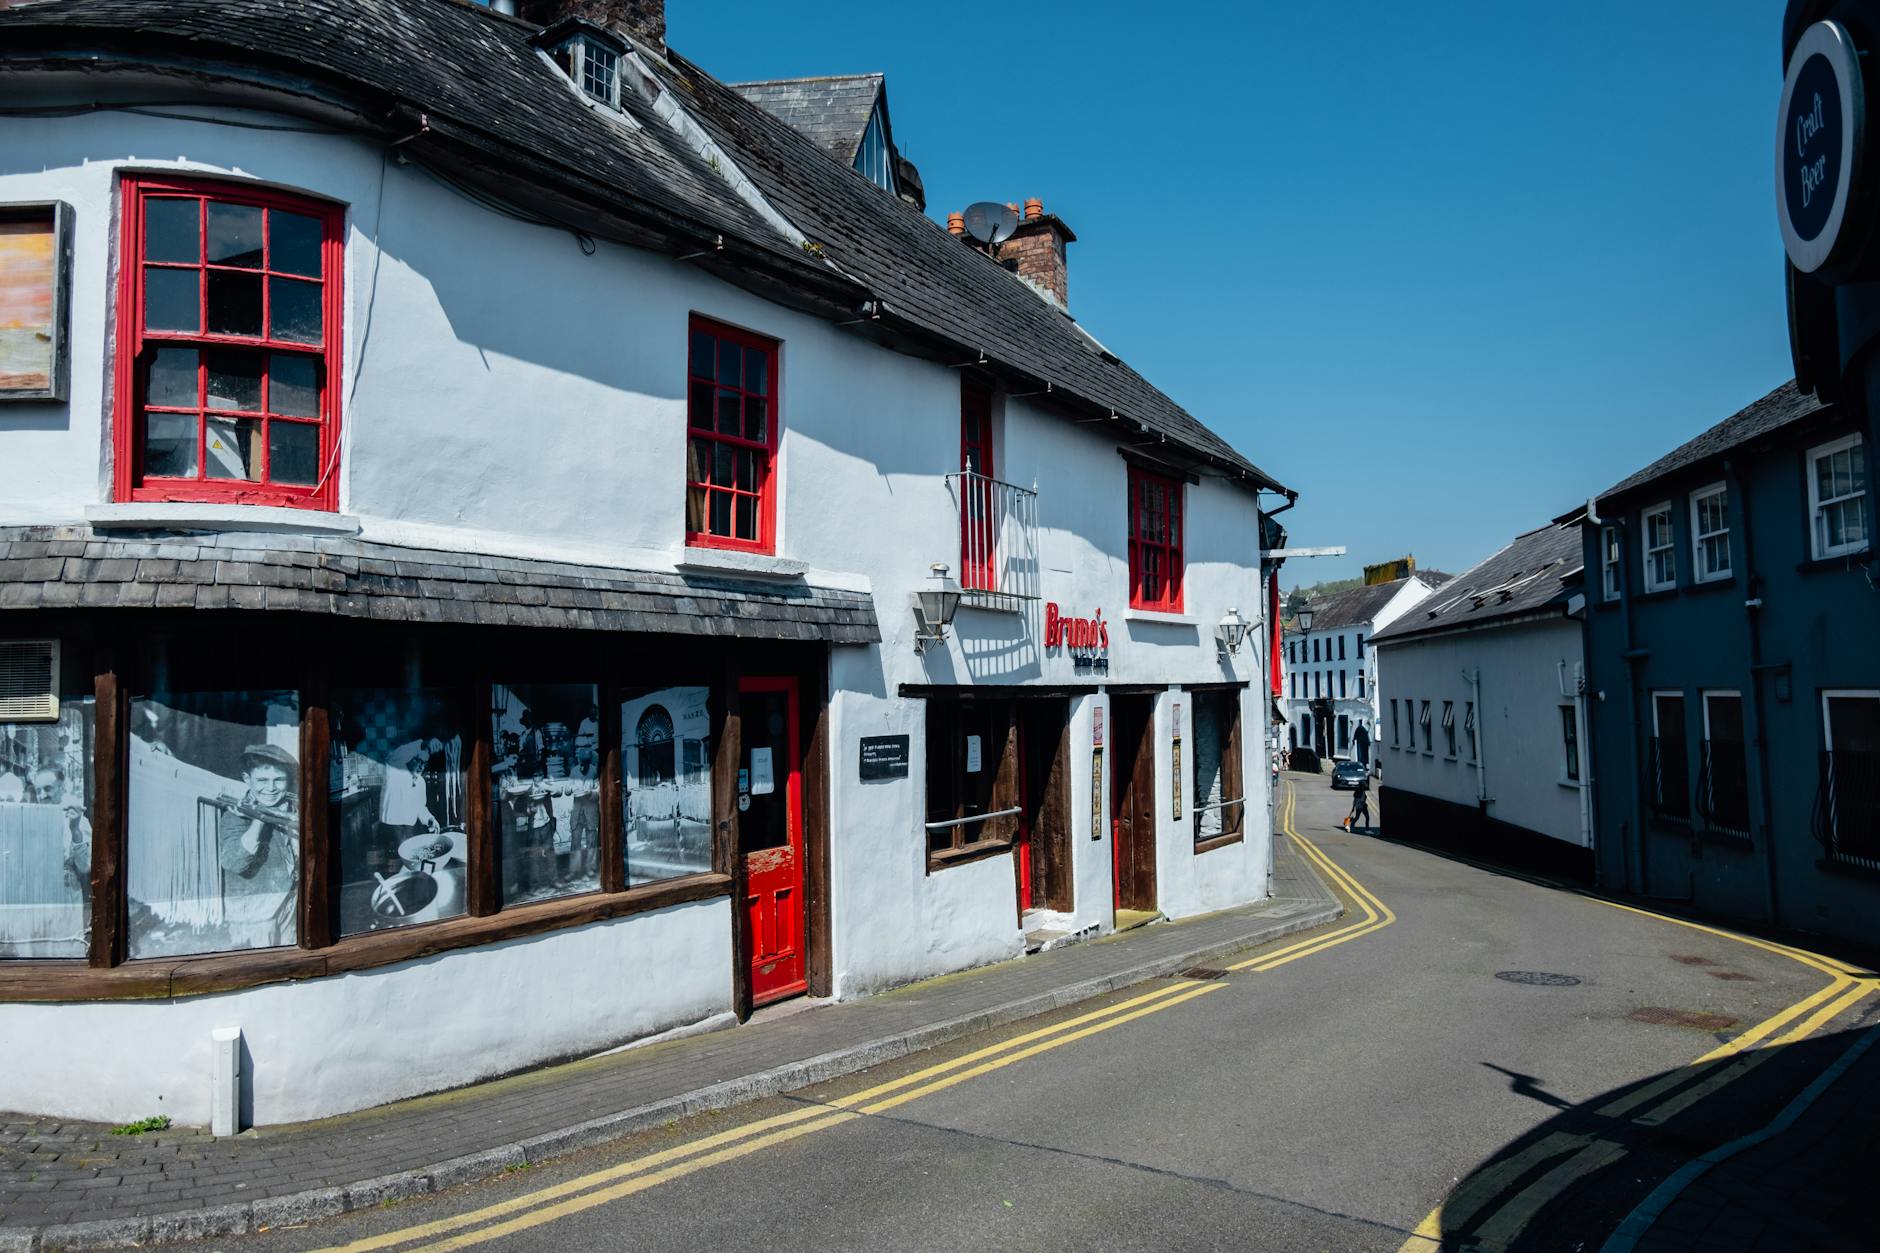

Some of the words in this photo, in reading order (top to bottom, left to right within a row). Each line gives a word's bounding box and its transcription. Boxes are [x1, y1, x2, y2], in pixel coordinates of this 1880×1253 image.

[1797, 92, 1824, 157] Craft
[1801, 154, 1826, 208] Beer
[1045, 602, 1109, 649] Bruno's
